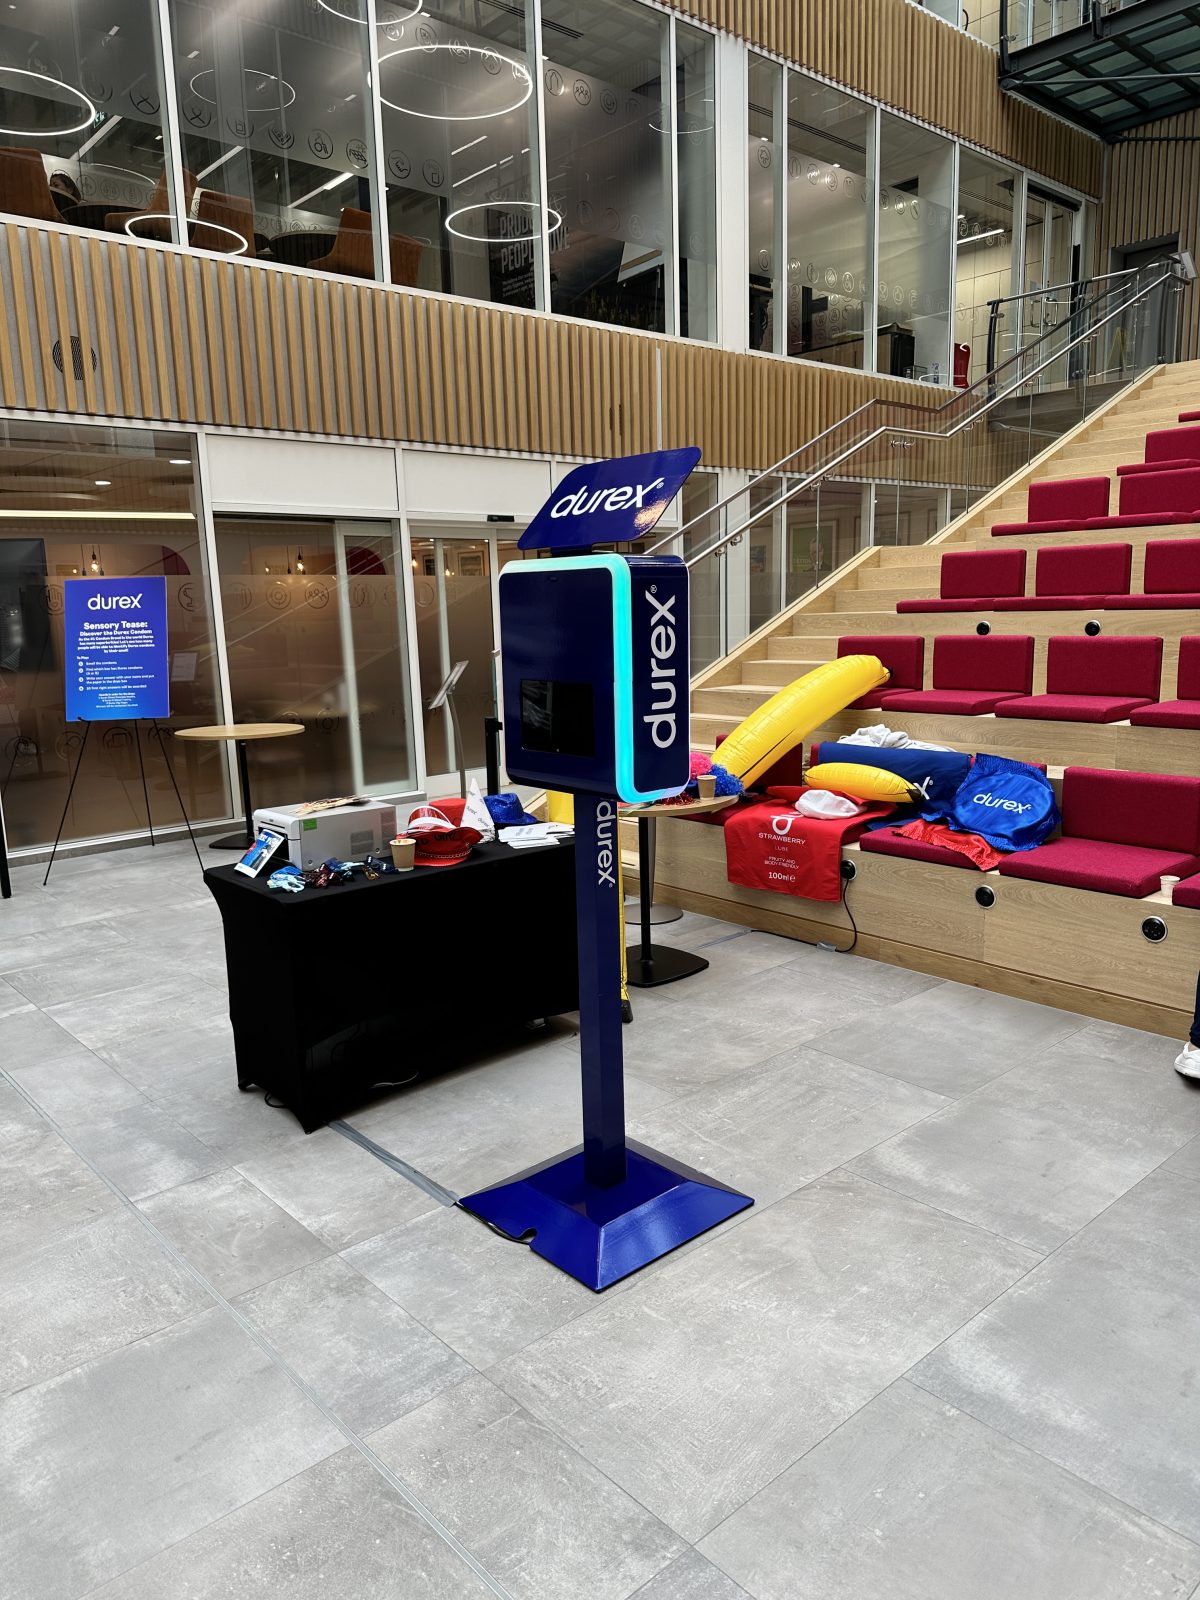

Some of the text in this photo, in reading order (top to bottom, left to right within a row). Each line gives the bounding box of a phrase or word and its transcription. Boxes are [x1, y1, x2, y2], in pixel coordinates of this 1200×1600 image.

[87, 593, 143, 611] durex
[83, 622, 119, 630] Sensory
[758, 832, 806, 845] STRAWBERRY
